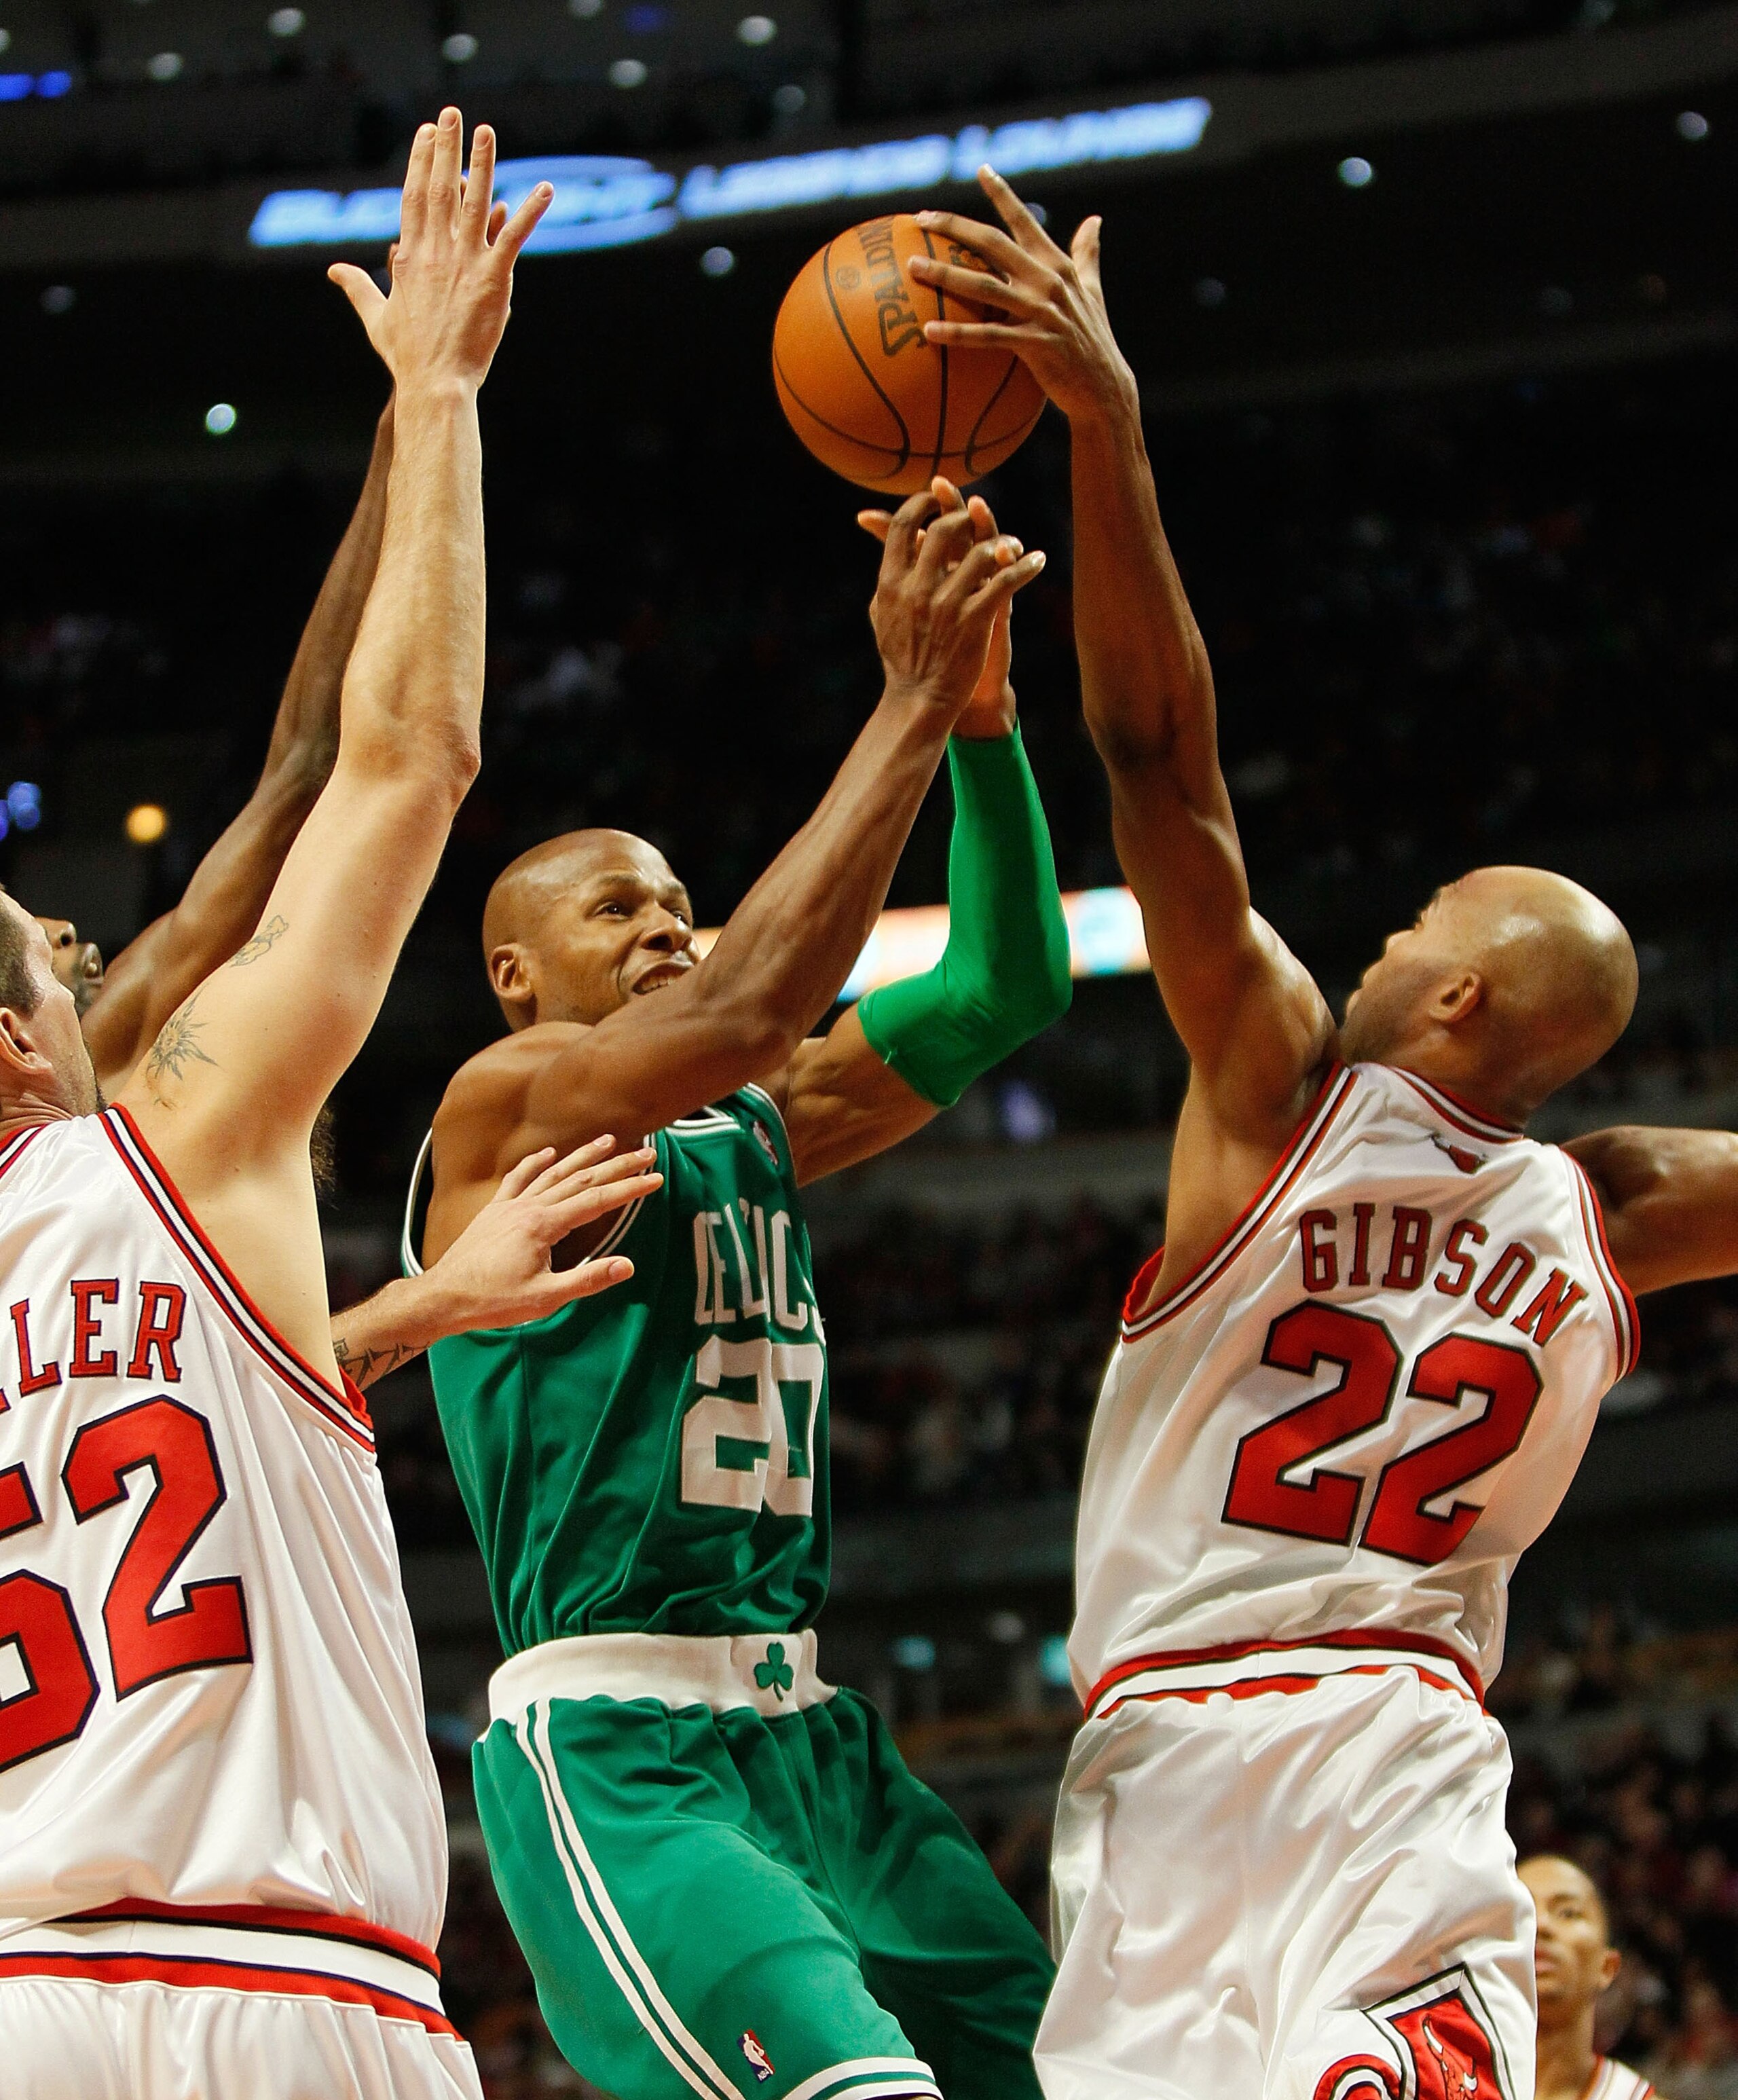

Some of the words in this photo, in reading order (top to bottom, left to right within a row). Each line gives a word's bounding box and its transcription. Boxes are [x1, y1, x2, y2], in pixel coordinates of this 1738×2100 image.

[0, 1278, 187, 1414] LER
[1299, 1202, 1589, 1348] GIBSON
[681, 1333, 825, 1517] 20
[1221, 1298, 1545, 1568] 22
